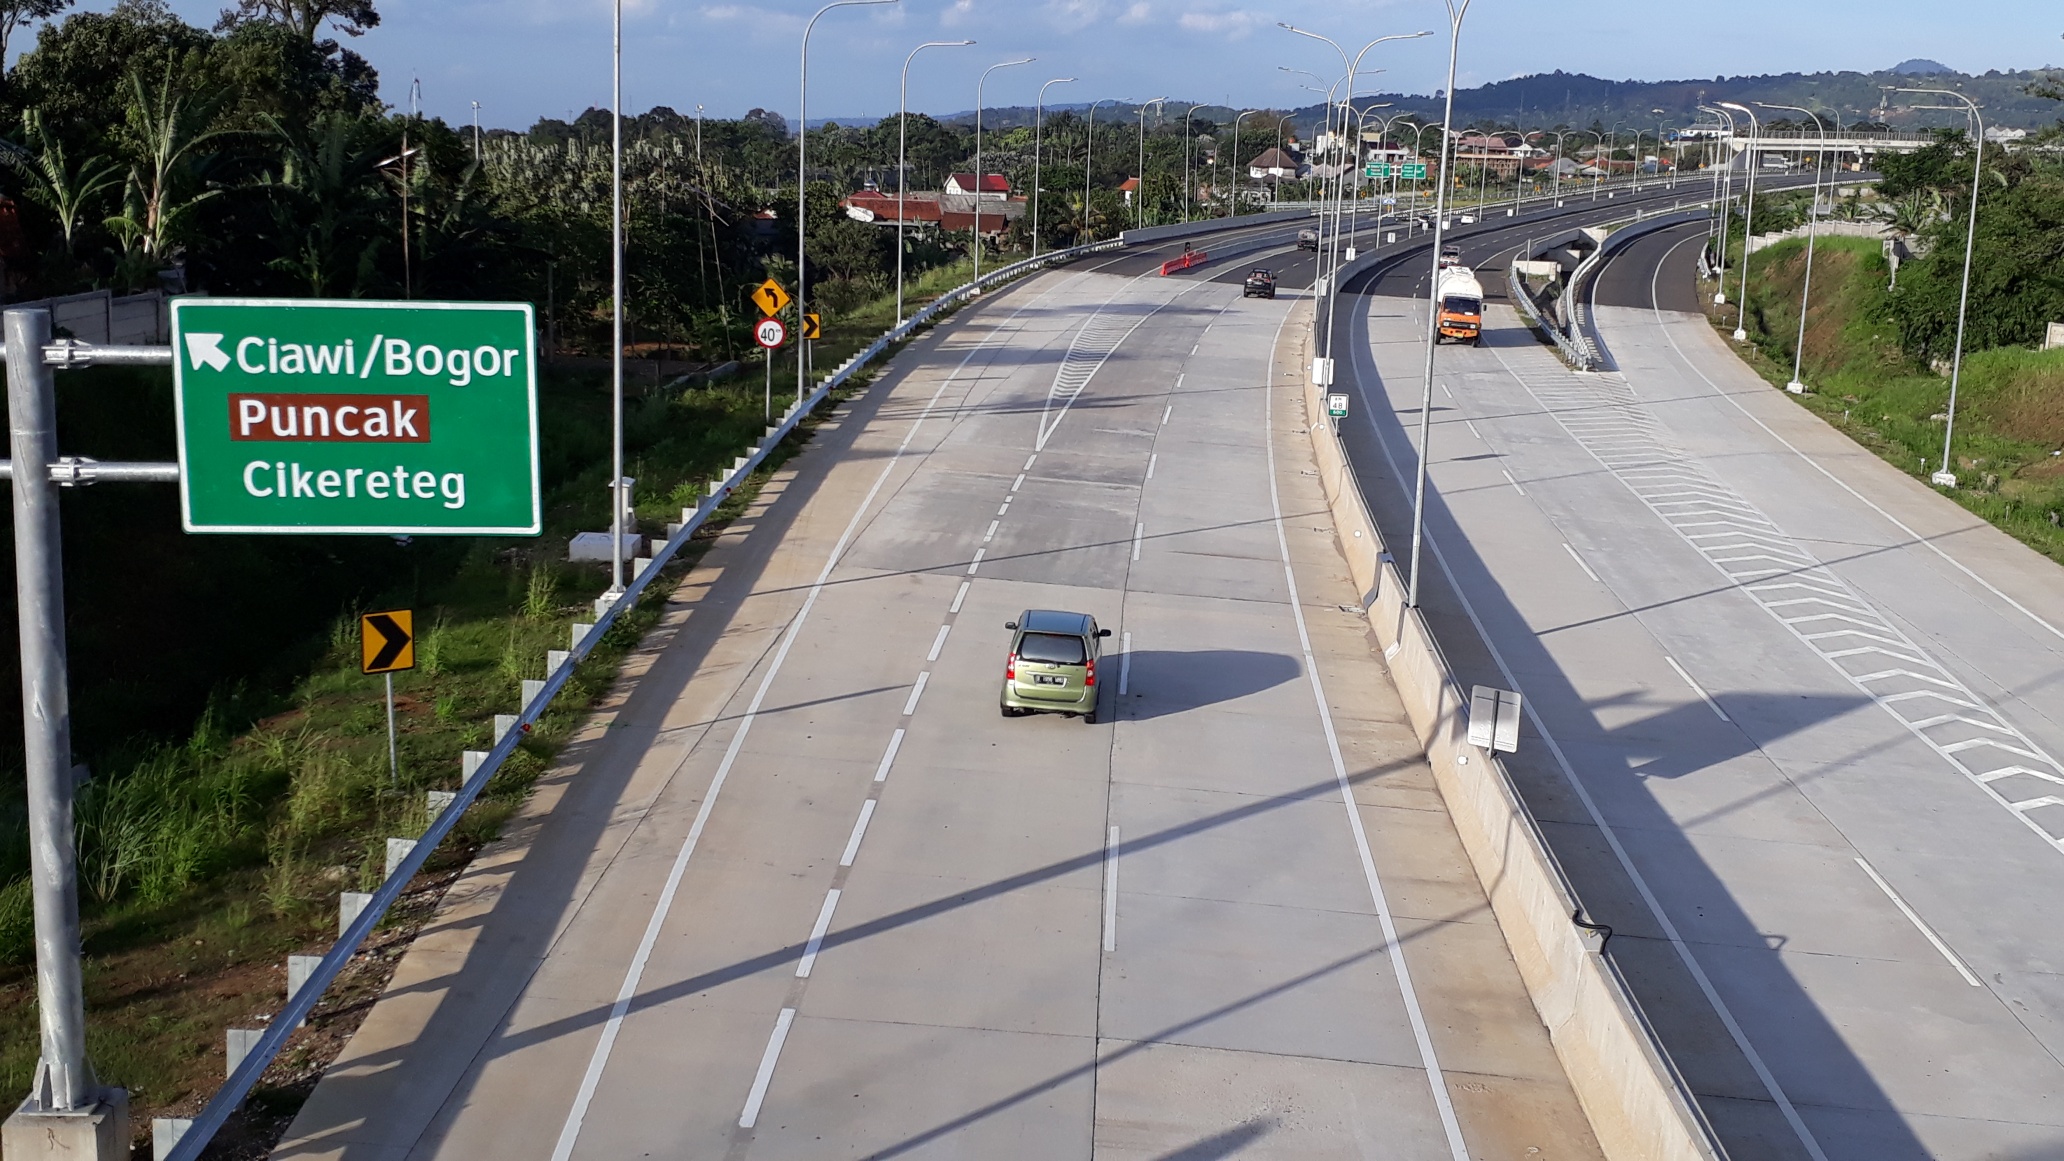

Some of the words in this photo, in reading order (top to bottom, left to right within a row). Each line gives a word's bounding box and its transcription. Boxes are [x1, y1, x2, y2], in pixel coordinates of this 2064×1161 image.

[761, 328, 775, 342] 40
[236, 334, 519, 386] Ciawi/Bogor
[239, 399, 419, 438] Puncak
[243, 460, 466, 509] Cikereteg
